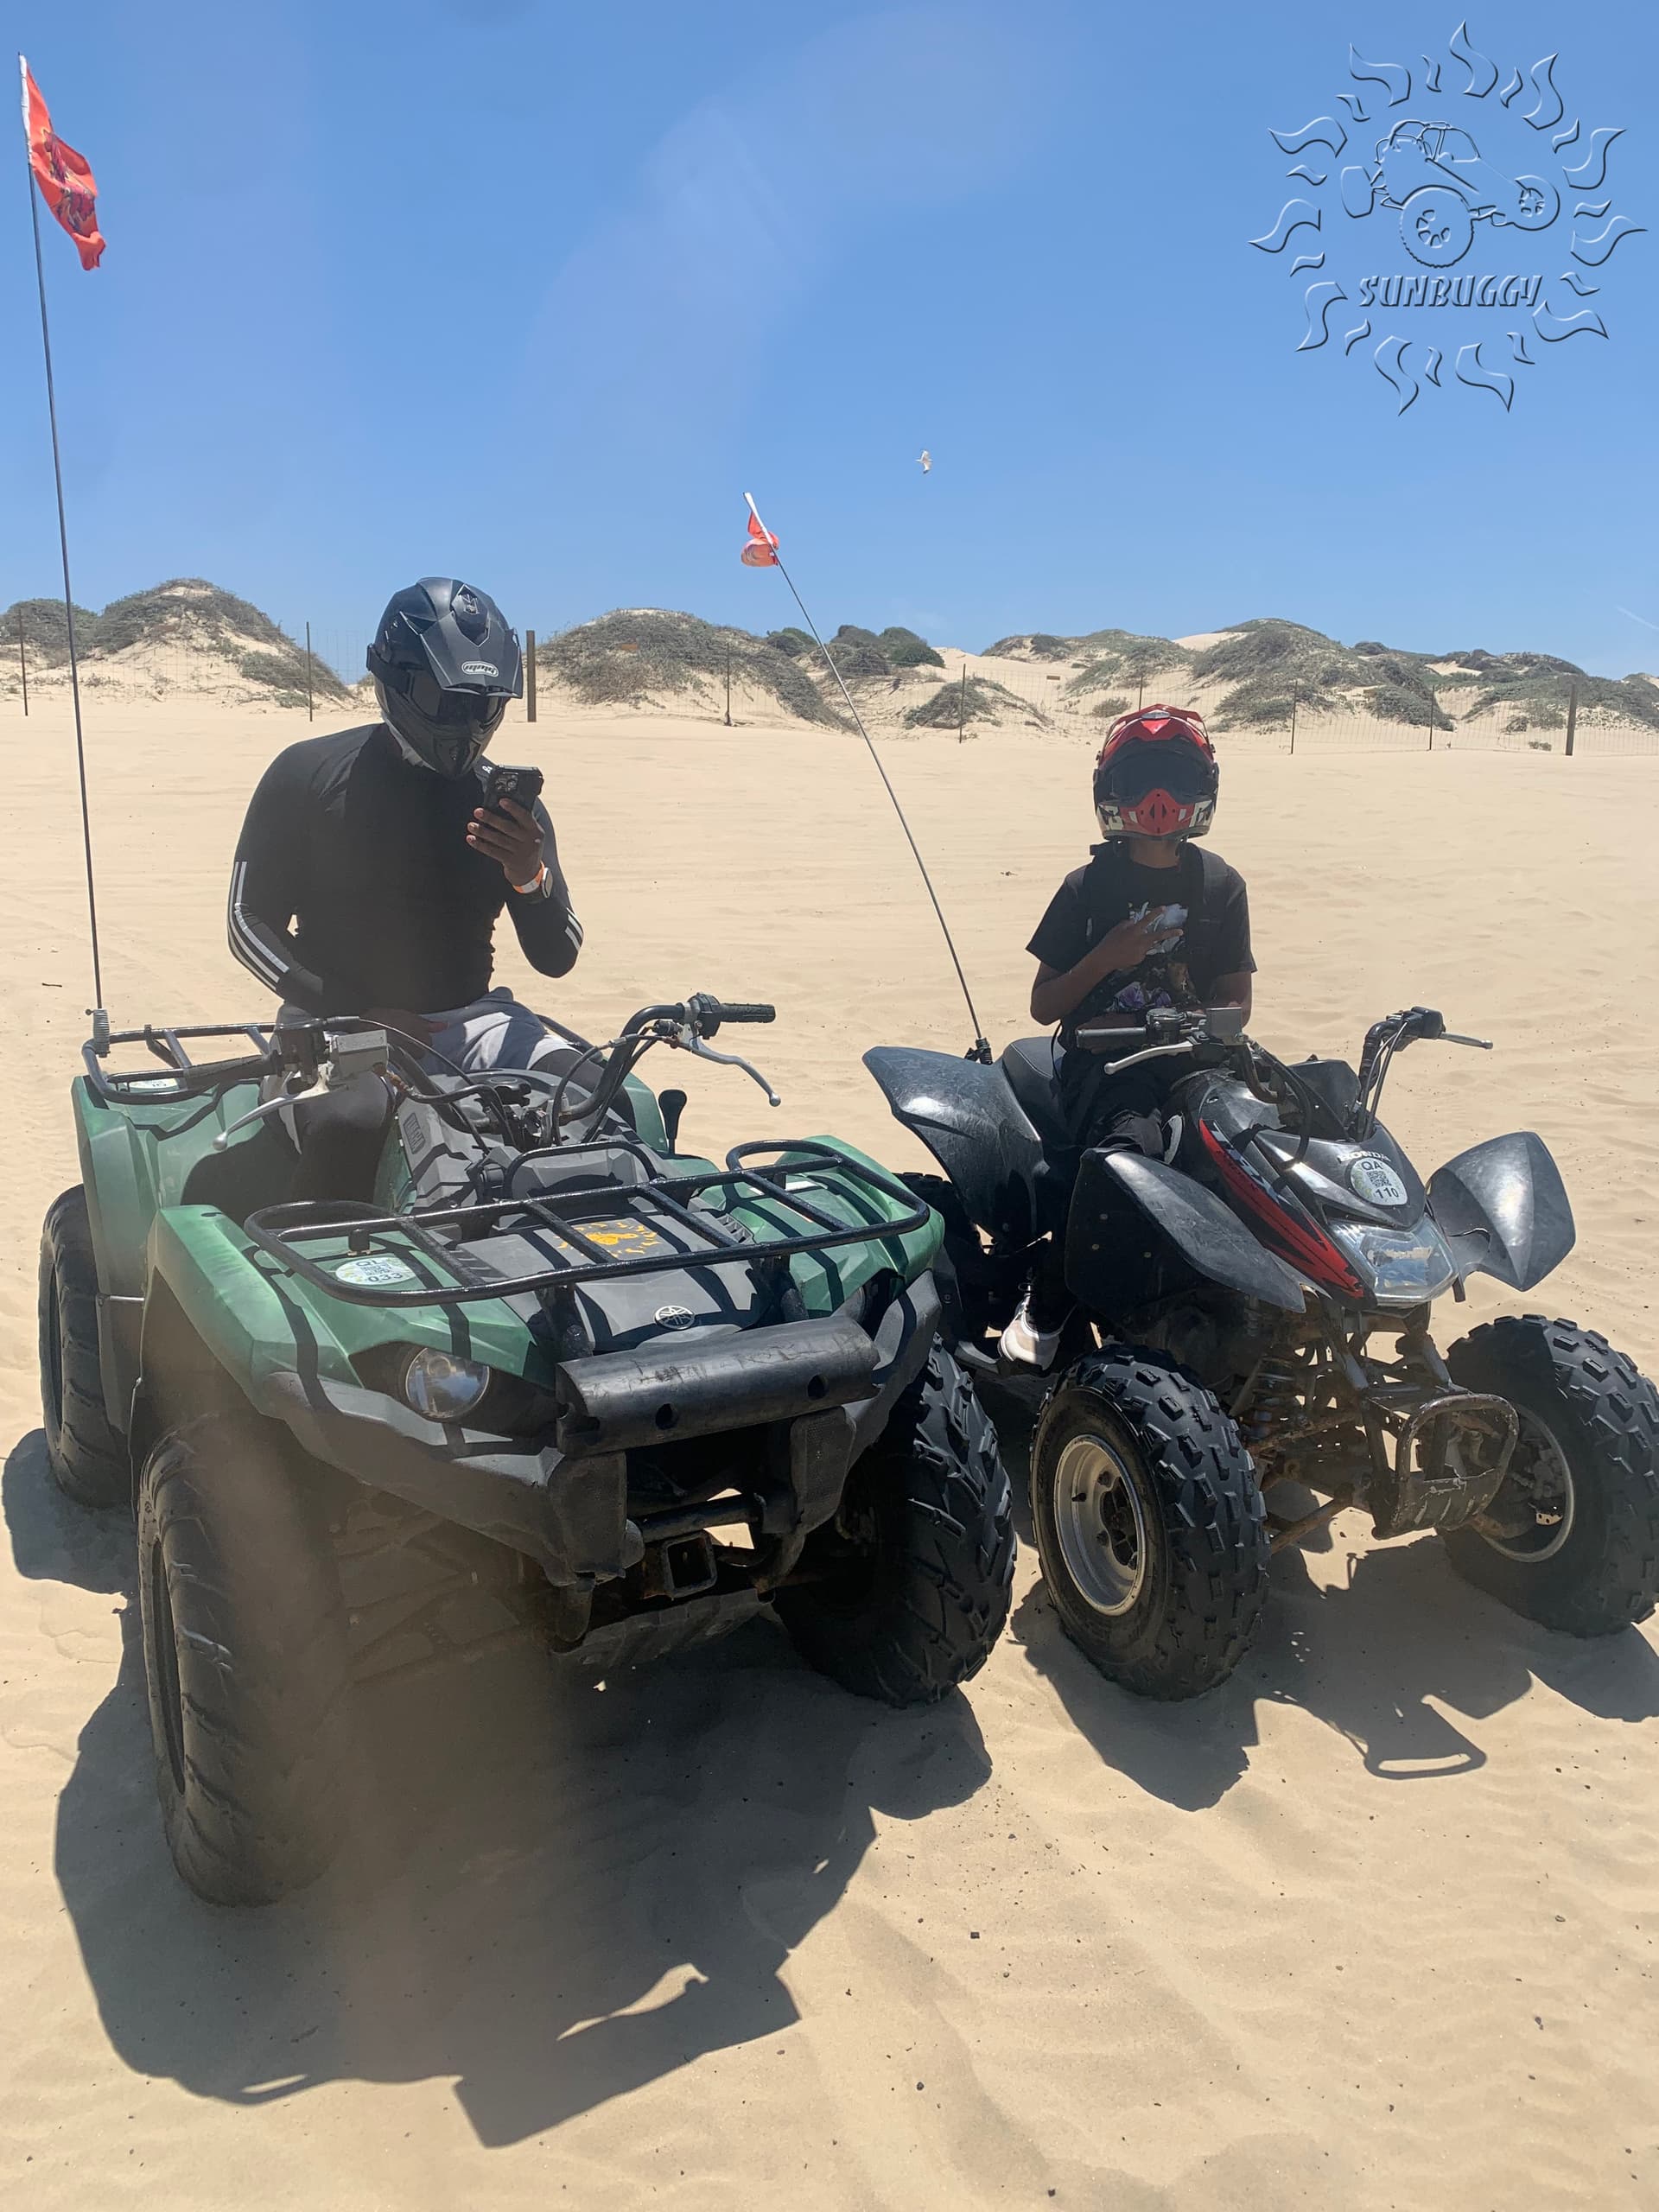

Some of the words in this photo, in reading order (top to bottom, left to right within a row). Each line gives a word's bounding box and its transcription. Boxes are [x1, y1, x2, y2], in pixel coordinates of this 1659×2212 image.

[1337, 1150, 1391, 1162] HONDA
[1361, 1160, 1383, 1171] QA
[1375, 1187, 1399, 1198] 110
[368, 1272, 403, 1282] 033
